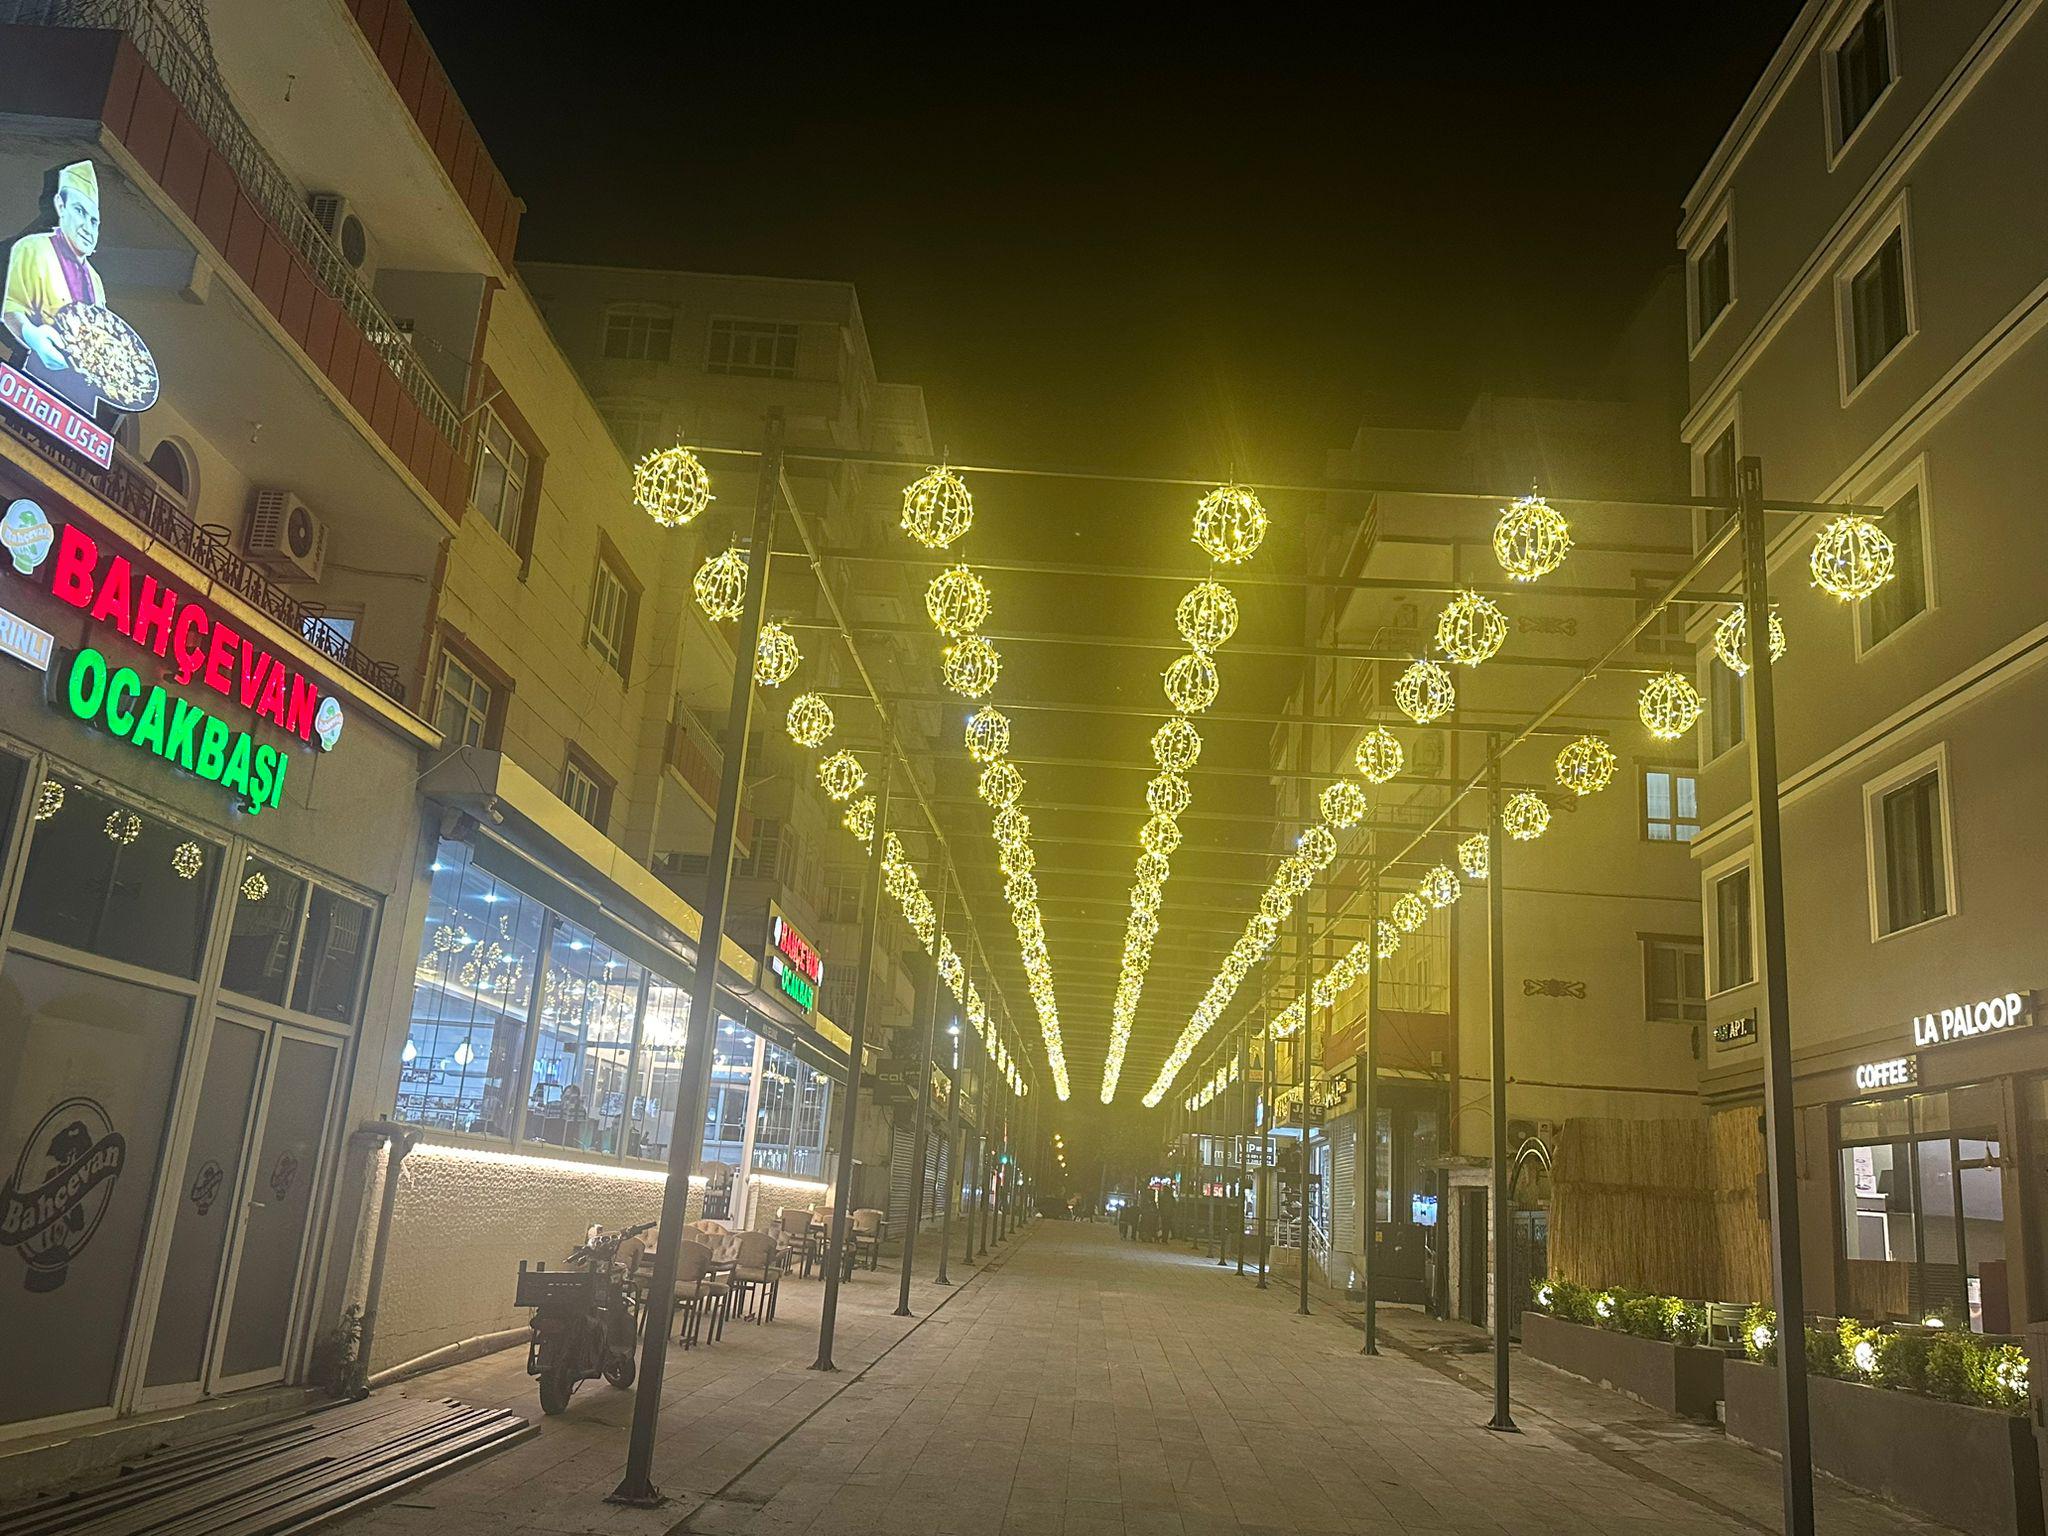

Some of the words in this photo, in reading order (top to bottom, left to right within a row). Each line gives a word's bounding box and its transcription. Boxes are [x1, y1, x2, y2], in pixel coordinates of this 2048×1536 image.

[0, 373, 62, 429] Orhan
[65, 415, 109, 460] Usta
[52, 524, 318, 741] BAHÇEVAN
[69, 648, 289, 815] OCAKBAŞI
[1729, 1018, 1748, 1038] APT.
[1913, 1014, 1940, 1046] LA
[1940, 992, 2022, 1041] PALOOP
[1856, 1057, 1909, 1089] COFFEE
